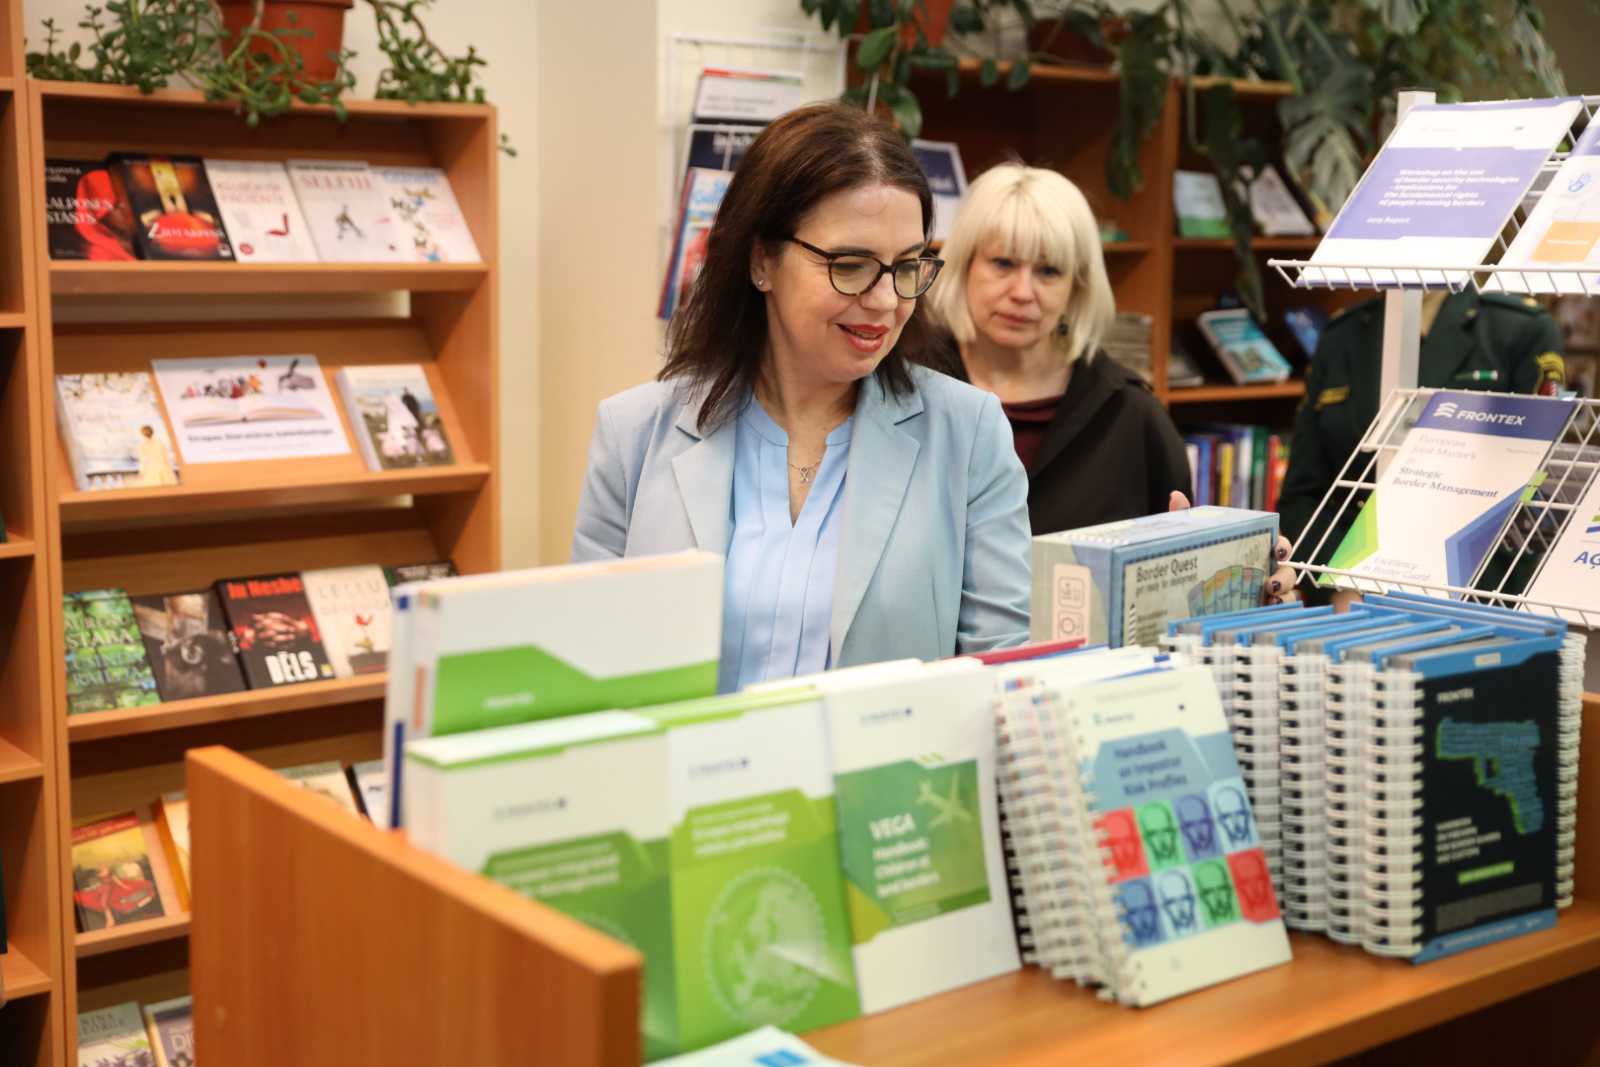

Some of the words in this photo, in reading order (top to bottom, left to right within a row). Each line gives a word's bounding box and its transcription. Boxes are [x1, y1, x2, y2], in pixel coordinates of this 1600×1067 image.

[1394, 176, 1405, 184] of
[1404, 176, 1431, 184] border
[1431, 176, 1464, 185] security
[1465, 176, 1520, 184] technologies
[1399, 169, 1440, 178] Workshop
[1444, 184, 1459, 192] for
[1384, 191, 1398, 199] the
[1399, 191, 1452, 199] fundamental
[1453, 191, 1479, 200] rights
[45, 197, 115, 211] ALPONES
[1378, 199, 1389, 207] of
[1388, 199, 1416, 208] people
[1416, 200, 1451, 208] crossing
[1452, 199, 1486, 207] borders
[1384, 216, 1411, 225] Report
[1546, 238, 1591, 246] Information
[1456, 410, 1527, 426] FRONTEX
[1418, 434, 1467, 447] European
[1411, 445, 1435, 456] Joint
[1435, 447, 1477, 460] Master's
[1405, 456, 1416, 465] in
[1399, 466, 1444, 480] Strategic
[1392, 477, 1429, 489] Border
[1429, 482, 1498, 499] Management
[1136, 562, 1168, 583] Border
[1170, 556, 1198, 574] Quest
[1374, 556, 1418, 570] Excellency
[1170, 573, 1198, 587] deployment
[1372, 565, 1401, 577] Border
[1402, 570, 1431, 582] Guard
[264, 650, 318, 685] DĒLS
[1113, 739, 1168, 759] Handbook
[1123, 782, 1146, 797] Risk
[1148, 774, 1189, 791] Profiles
[868, 812, 917, 841] VEGA
[874, 858, 918, 880] Children
